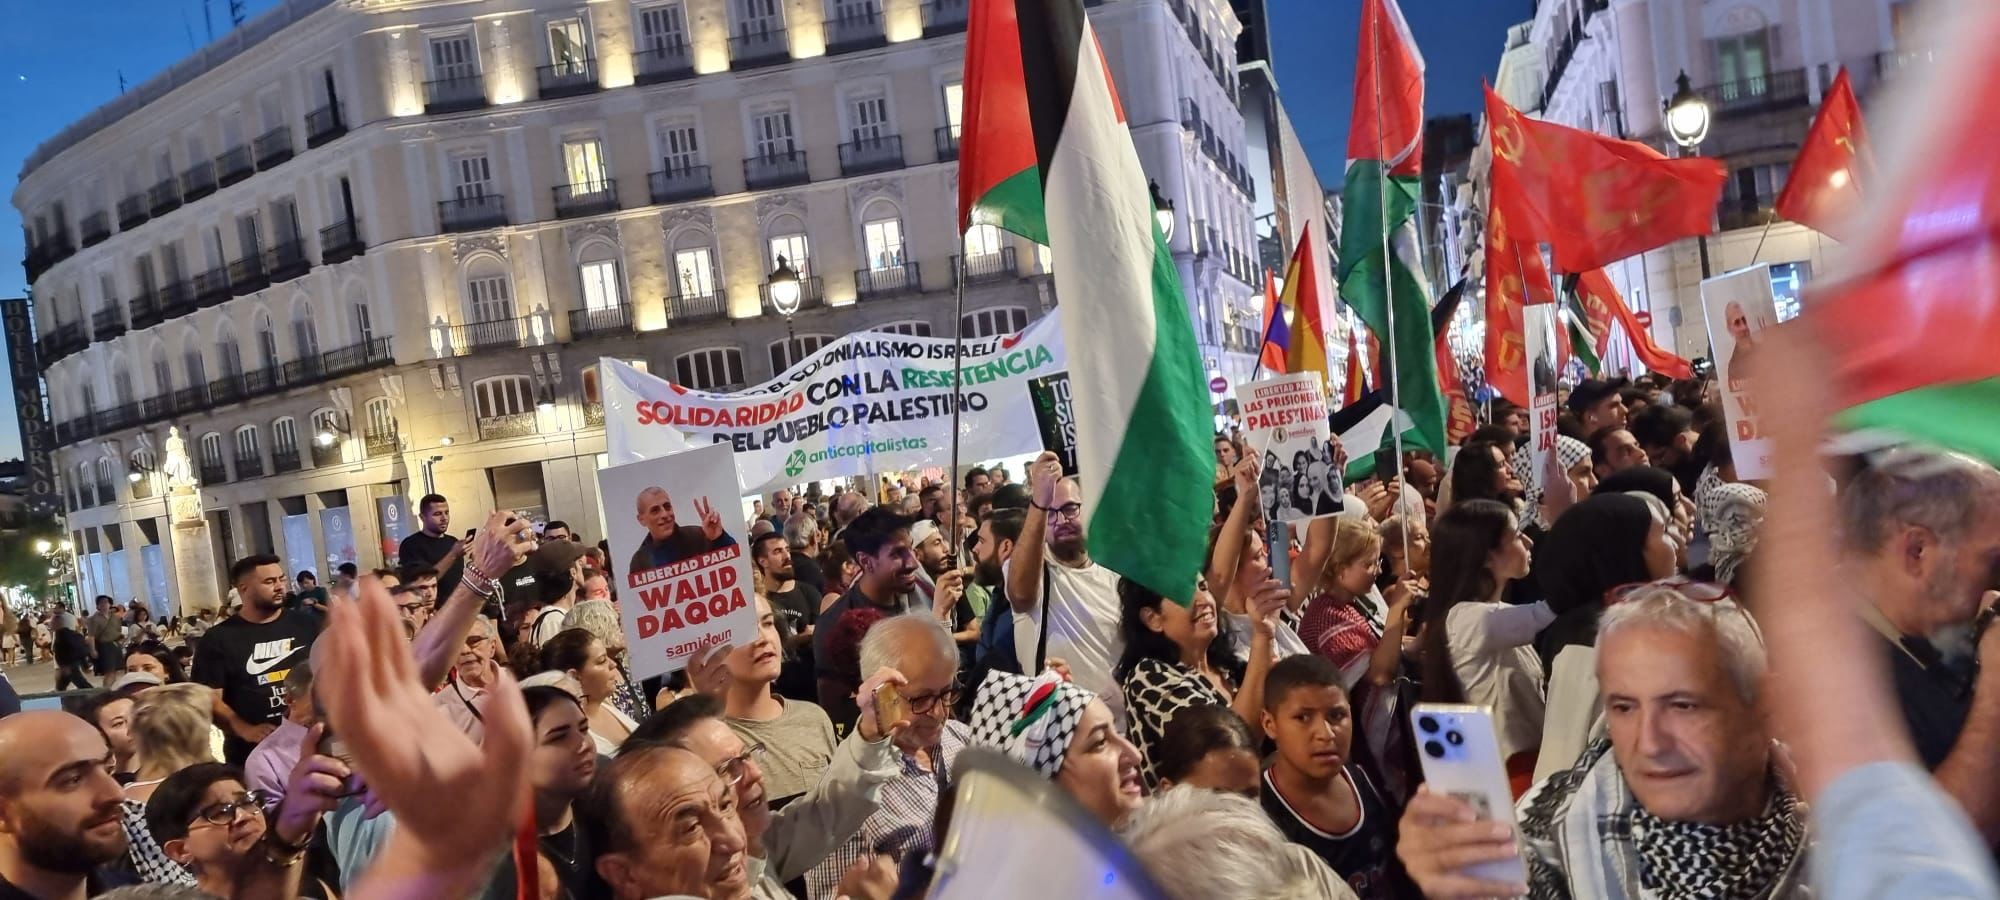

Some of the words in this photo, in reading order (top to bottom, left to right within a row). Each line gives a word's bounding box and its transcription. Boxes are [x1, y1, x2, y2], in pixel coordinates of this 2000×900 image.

[5, 302, 28, 377] HOTEL
[789, 340, 924, 383] COLONIALISMO
[926, 336, 1001, 360] ISRAELÍ
[635, 390, 806, 428] SOLIDARIDAD
[805, 372, 861, 405] CON
[864, 368, 900, 395] LA
[901, 343, 1054, 390] RESISTENCIA
[1255, 383, 1295, 398] LIBERTAD
[762, 405, 850, 450] PUEBLO
[852, 391, 988, 426] PALESTINO
[1244, 400, 1264, 414] LAS
[1247, 405, 1326, 431] PALESTINAS
[18, 389, 50, 495] MODERNO
[808, 436, 928, 464] anticapitalistas
[634, 559, 699, 586] LIBERTAD
[702, 547, 735, 567] PARA
[638, 565, 738, 611] WALID
[636, 587, 747, 640] DAQQA
[253, 638, 292, 660] NIKE
[665, 629, 732, 658] samidoun
